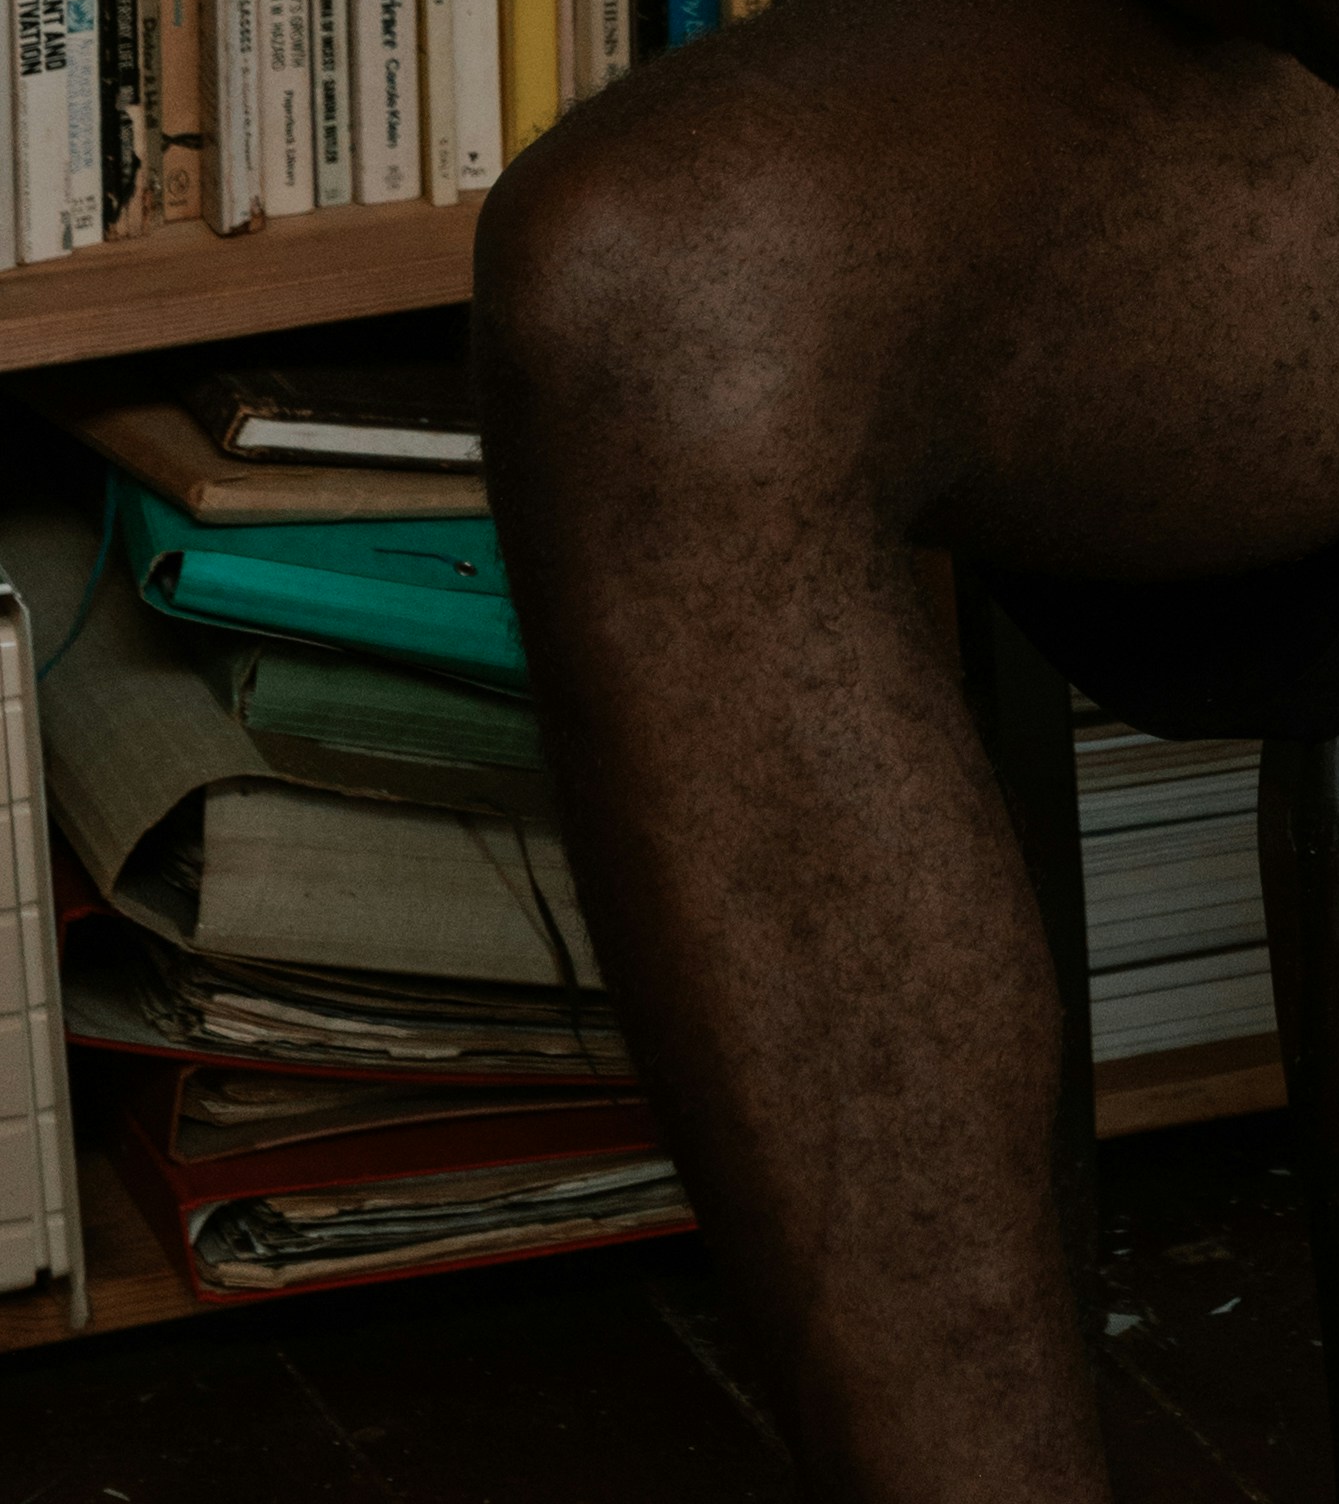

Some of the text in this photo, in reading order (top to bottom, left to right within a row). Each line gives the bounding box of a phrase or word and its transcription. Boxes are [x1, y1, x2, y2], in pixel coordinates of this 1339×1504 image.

[43, 31, 66, 72] AND
[383, 58, 401, 107] Carole
[282, 88, 297, 145] Paperback
[385, 110, 401, 150] Klein
